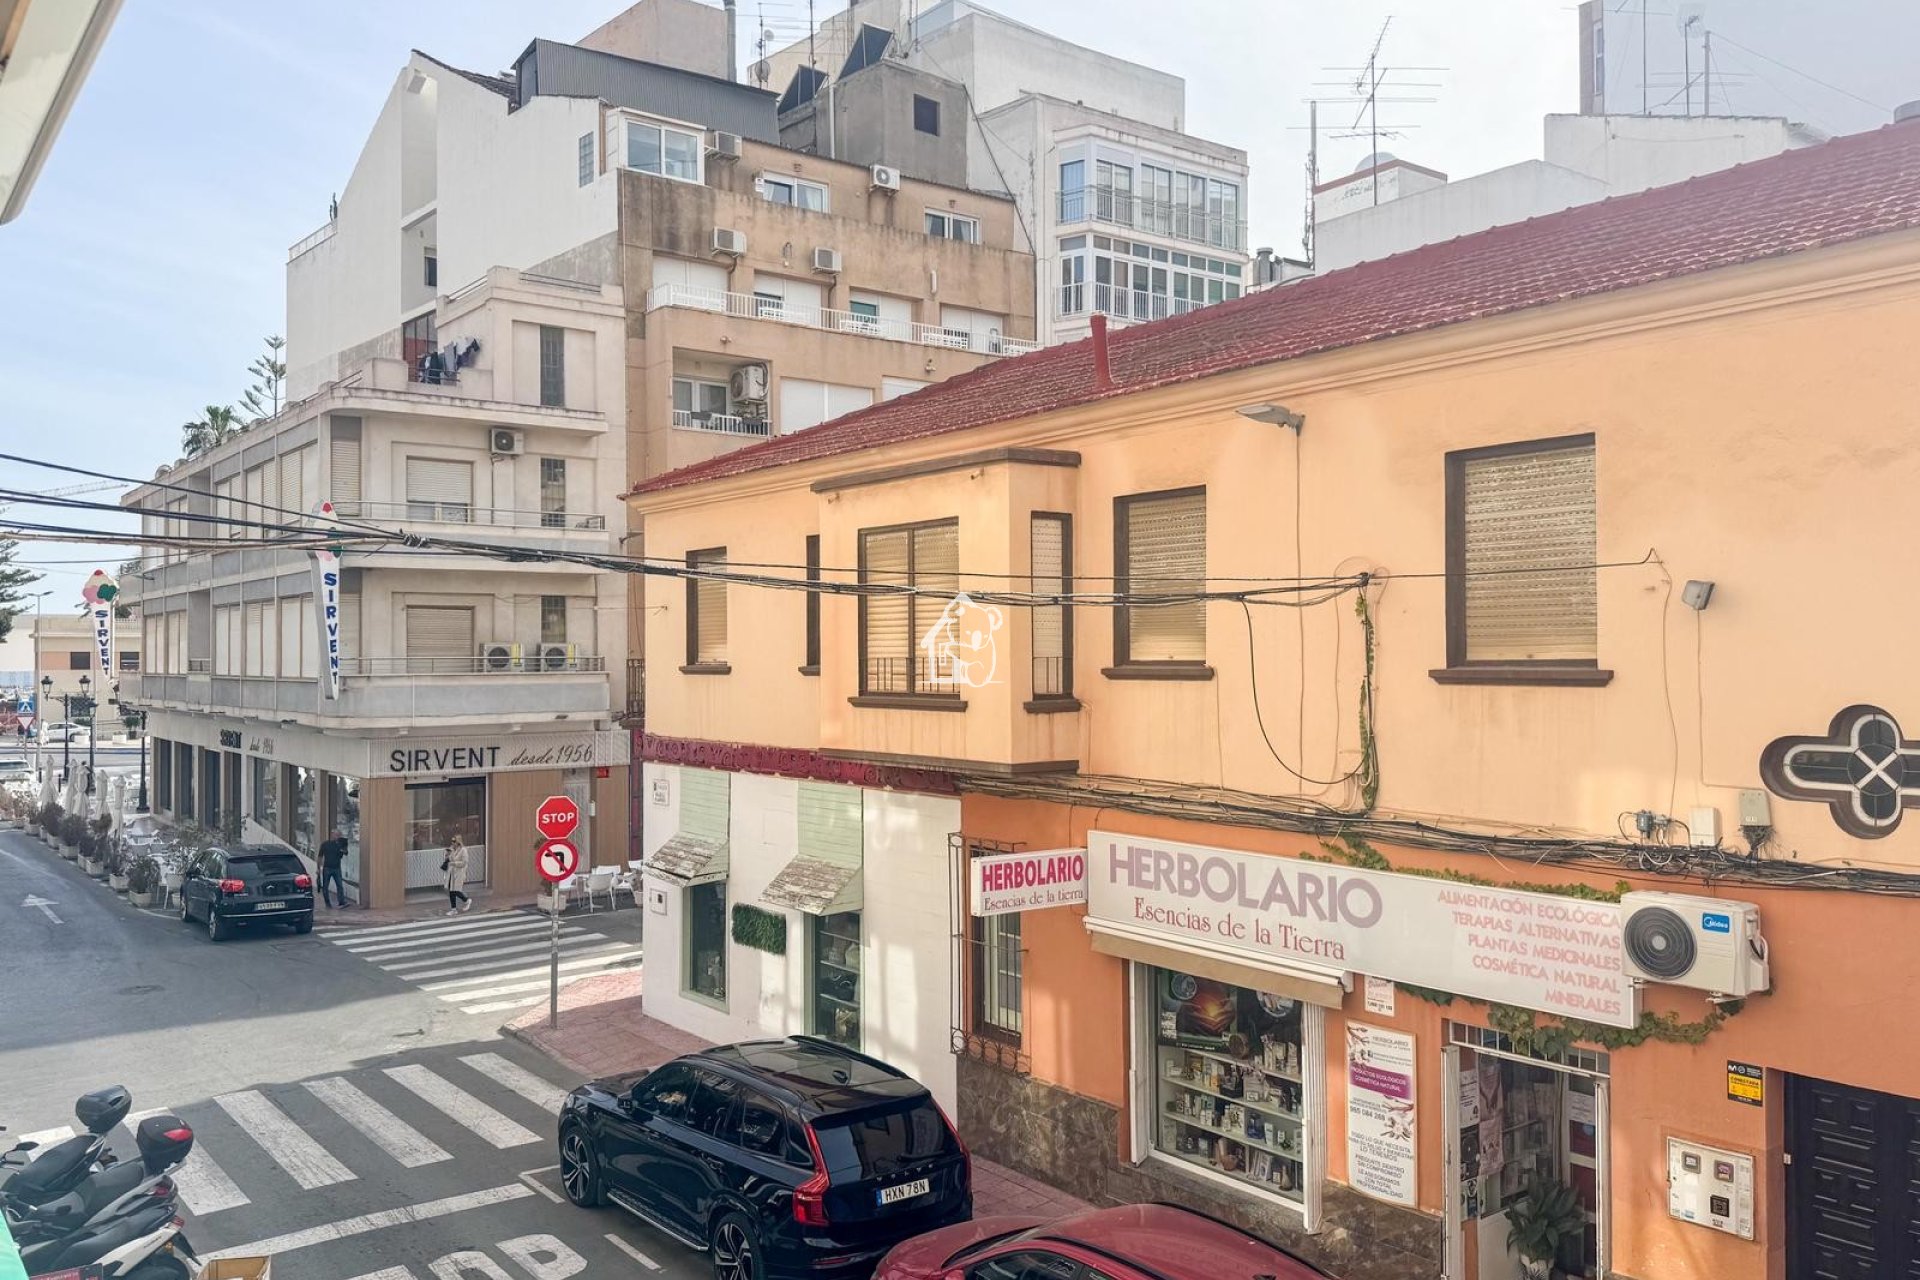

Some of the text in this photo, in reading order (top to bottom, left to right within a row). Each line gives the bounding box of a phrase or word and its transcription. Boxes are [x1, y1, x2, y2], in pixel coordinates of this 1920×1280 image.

[95, 609, 110, 676] SIRVENT
[323, 572, 338, 685] SIRVENT
[389, 743, 593, 772] SIRVENT desde 1956
[541, 812, 575, 824] STOP
[982, 855, 1084, 892] HERBOLARIO
[1109, 843, 1383, 928] HERBOLARIO
[984, 889, 1084, 911] Esencias de la tierra
[1438, 889, 1621, 929] ALIMENTACIÓN ECOLÓGICA
[1134, 897, 1346, 961] Esencias de la Tierra
[1452, 911, 1621, 950] TERAPIAS ALTERNATIVAS
[1468, 934, 1621, 972] PLANTAS MEDICINALES
[1472, 955, 1621, 994] COSMÉTICA NATURAL
[1545, 990, 1621, 1016] MINERALES
[885, 1180, 926, 1201] HXN 78N
